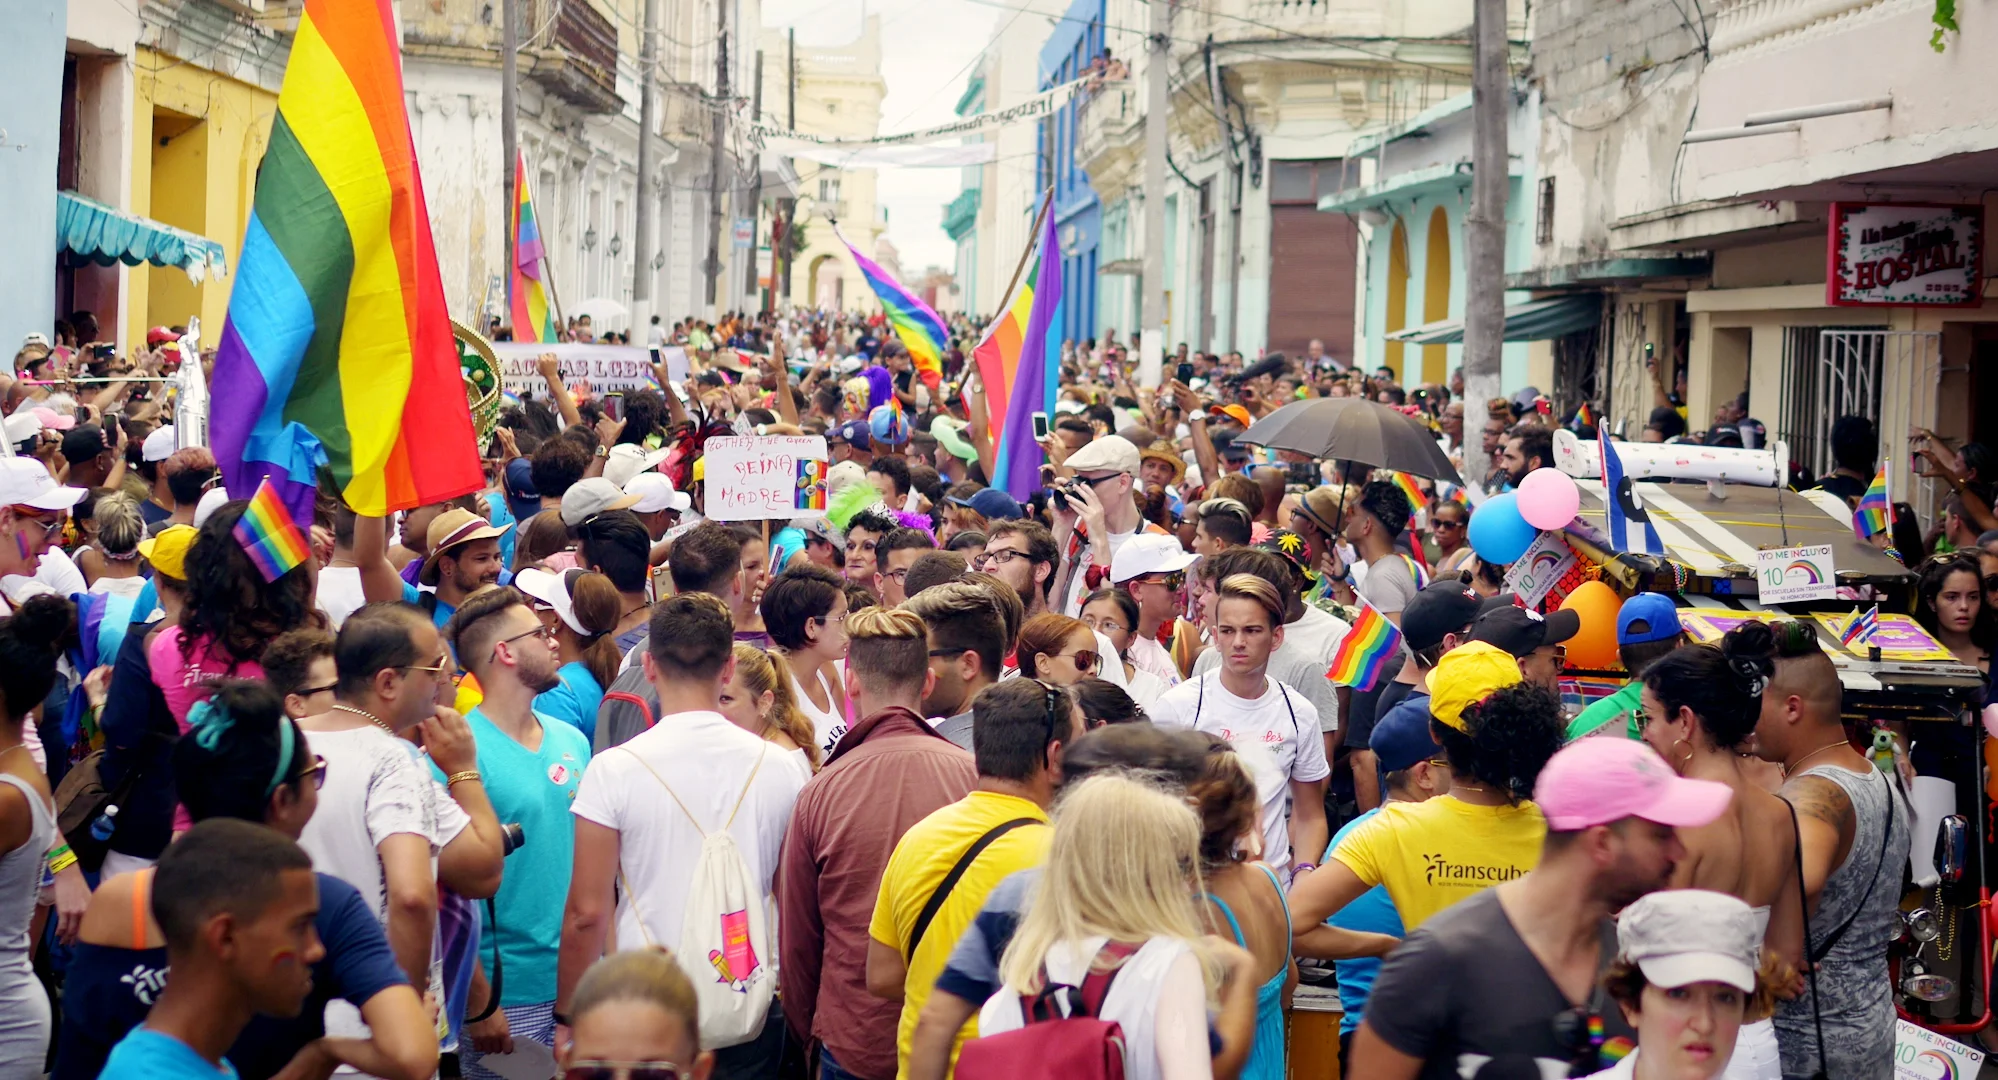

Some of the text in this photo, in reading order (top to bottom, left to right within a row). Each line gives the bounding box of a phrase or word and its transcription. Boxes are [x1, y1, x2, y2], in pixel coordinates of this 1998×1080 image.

[1854, 241, 1966, 290] HOSTAL
[759, 437, 779, 445] THE
[721, 485, 790, 511] MADRE
[1775, 550, 1789, 559] ME
[1791, 547, 1831, 558] INCLUYO!
[1516, 557, 1528, 570] ME
[1519, 574, 1535, 593] 10
[1763, 567, 1783, 586] 10
[1895, 1041, 1917, 1065] 10
[1917, 1030, 1934, 1043] ME
[1933, 1037, 1982, 1063] INCLUYO!
